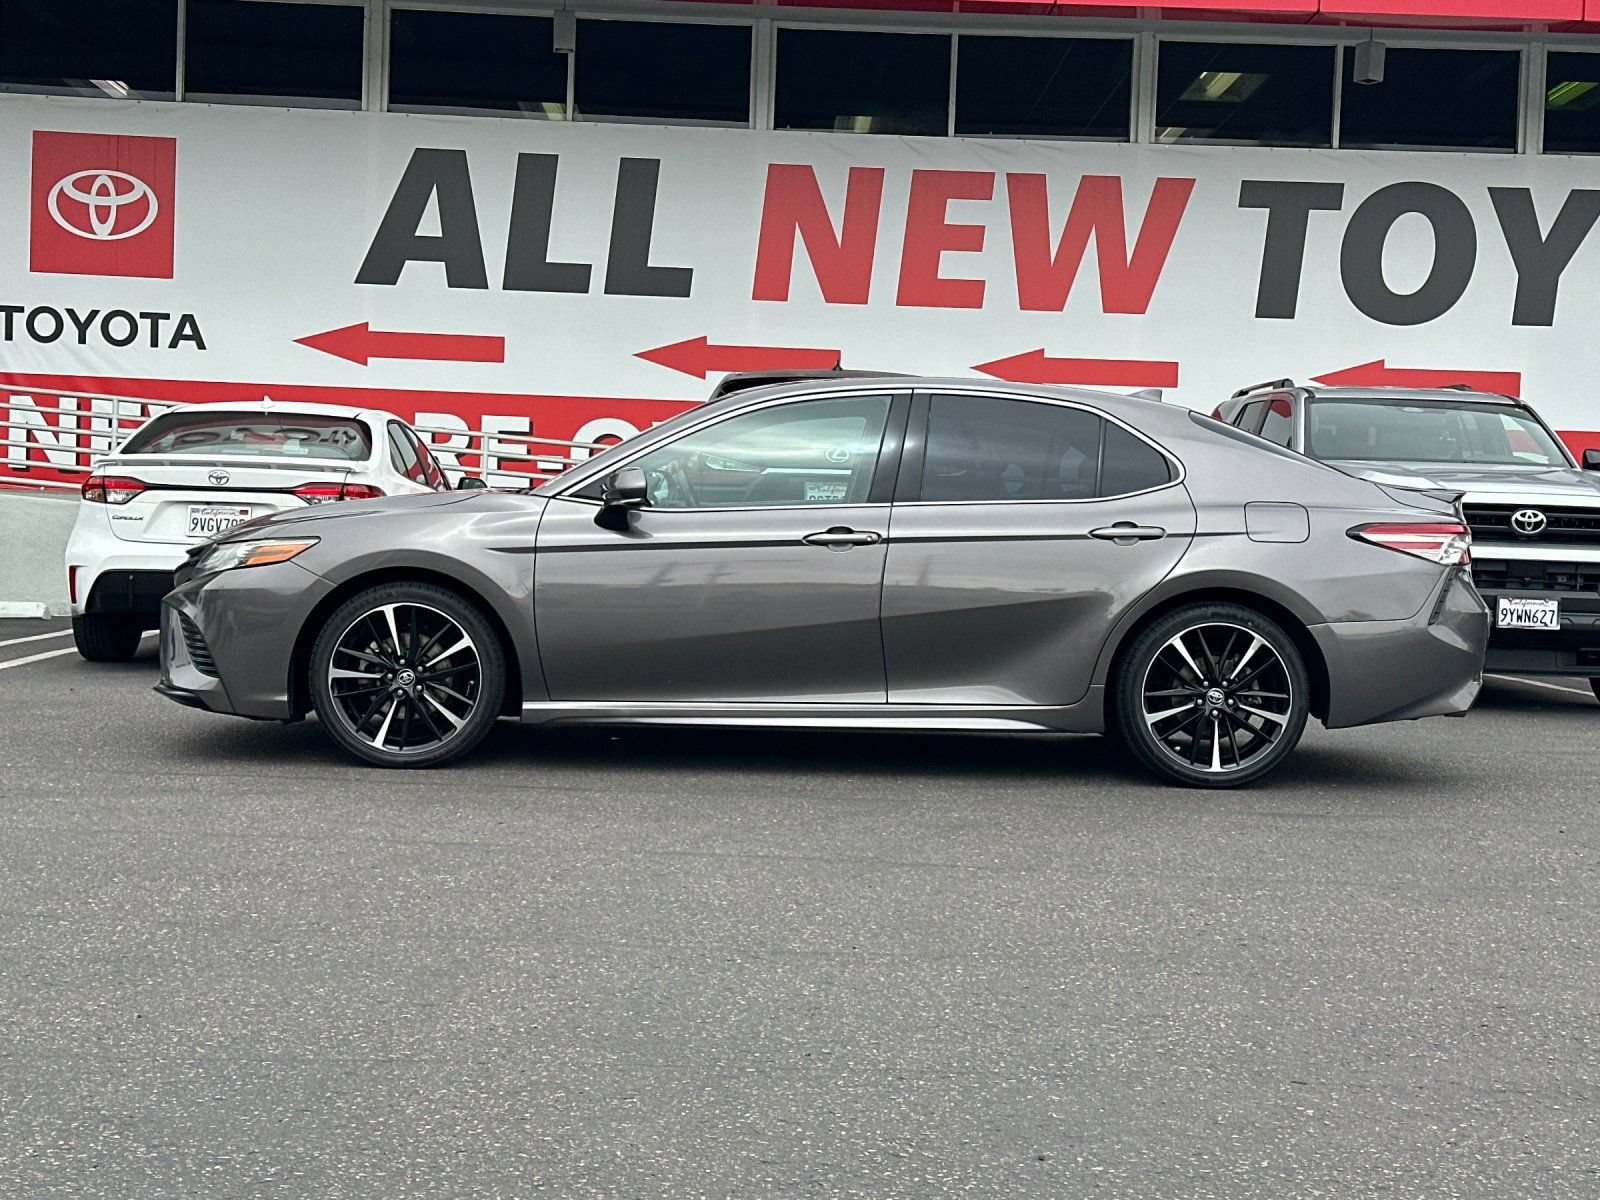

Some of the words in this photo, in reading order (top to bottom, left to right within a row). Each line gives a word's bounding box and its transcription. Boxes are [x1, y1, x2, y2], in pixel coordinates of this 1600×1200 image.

[355, 147, 692, 297] ALL
[753, 163, 1195, 314] NEW
[1240, 180, 1600, 326] TOY
[0, 305, 206, 350] TOYOTA
[1500, 607, 1556, 624] 9YWN627
